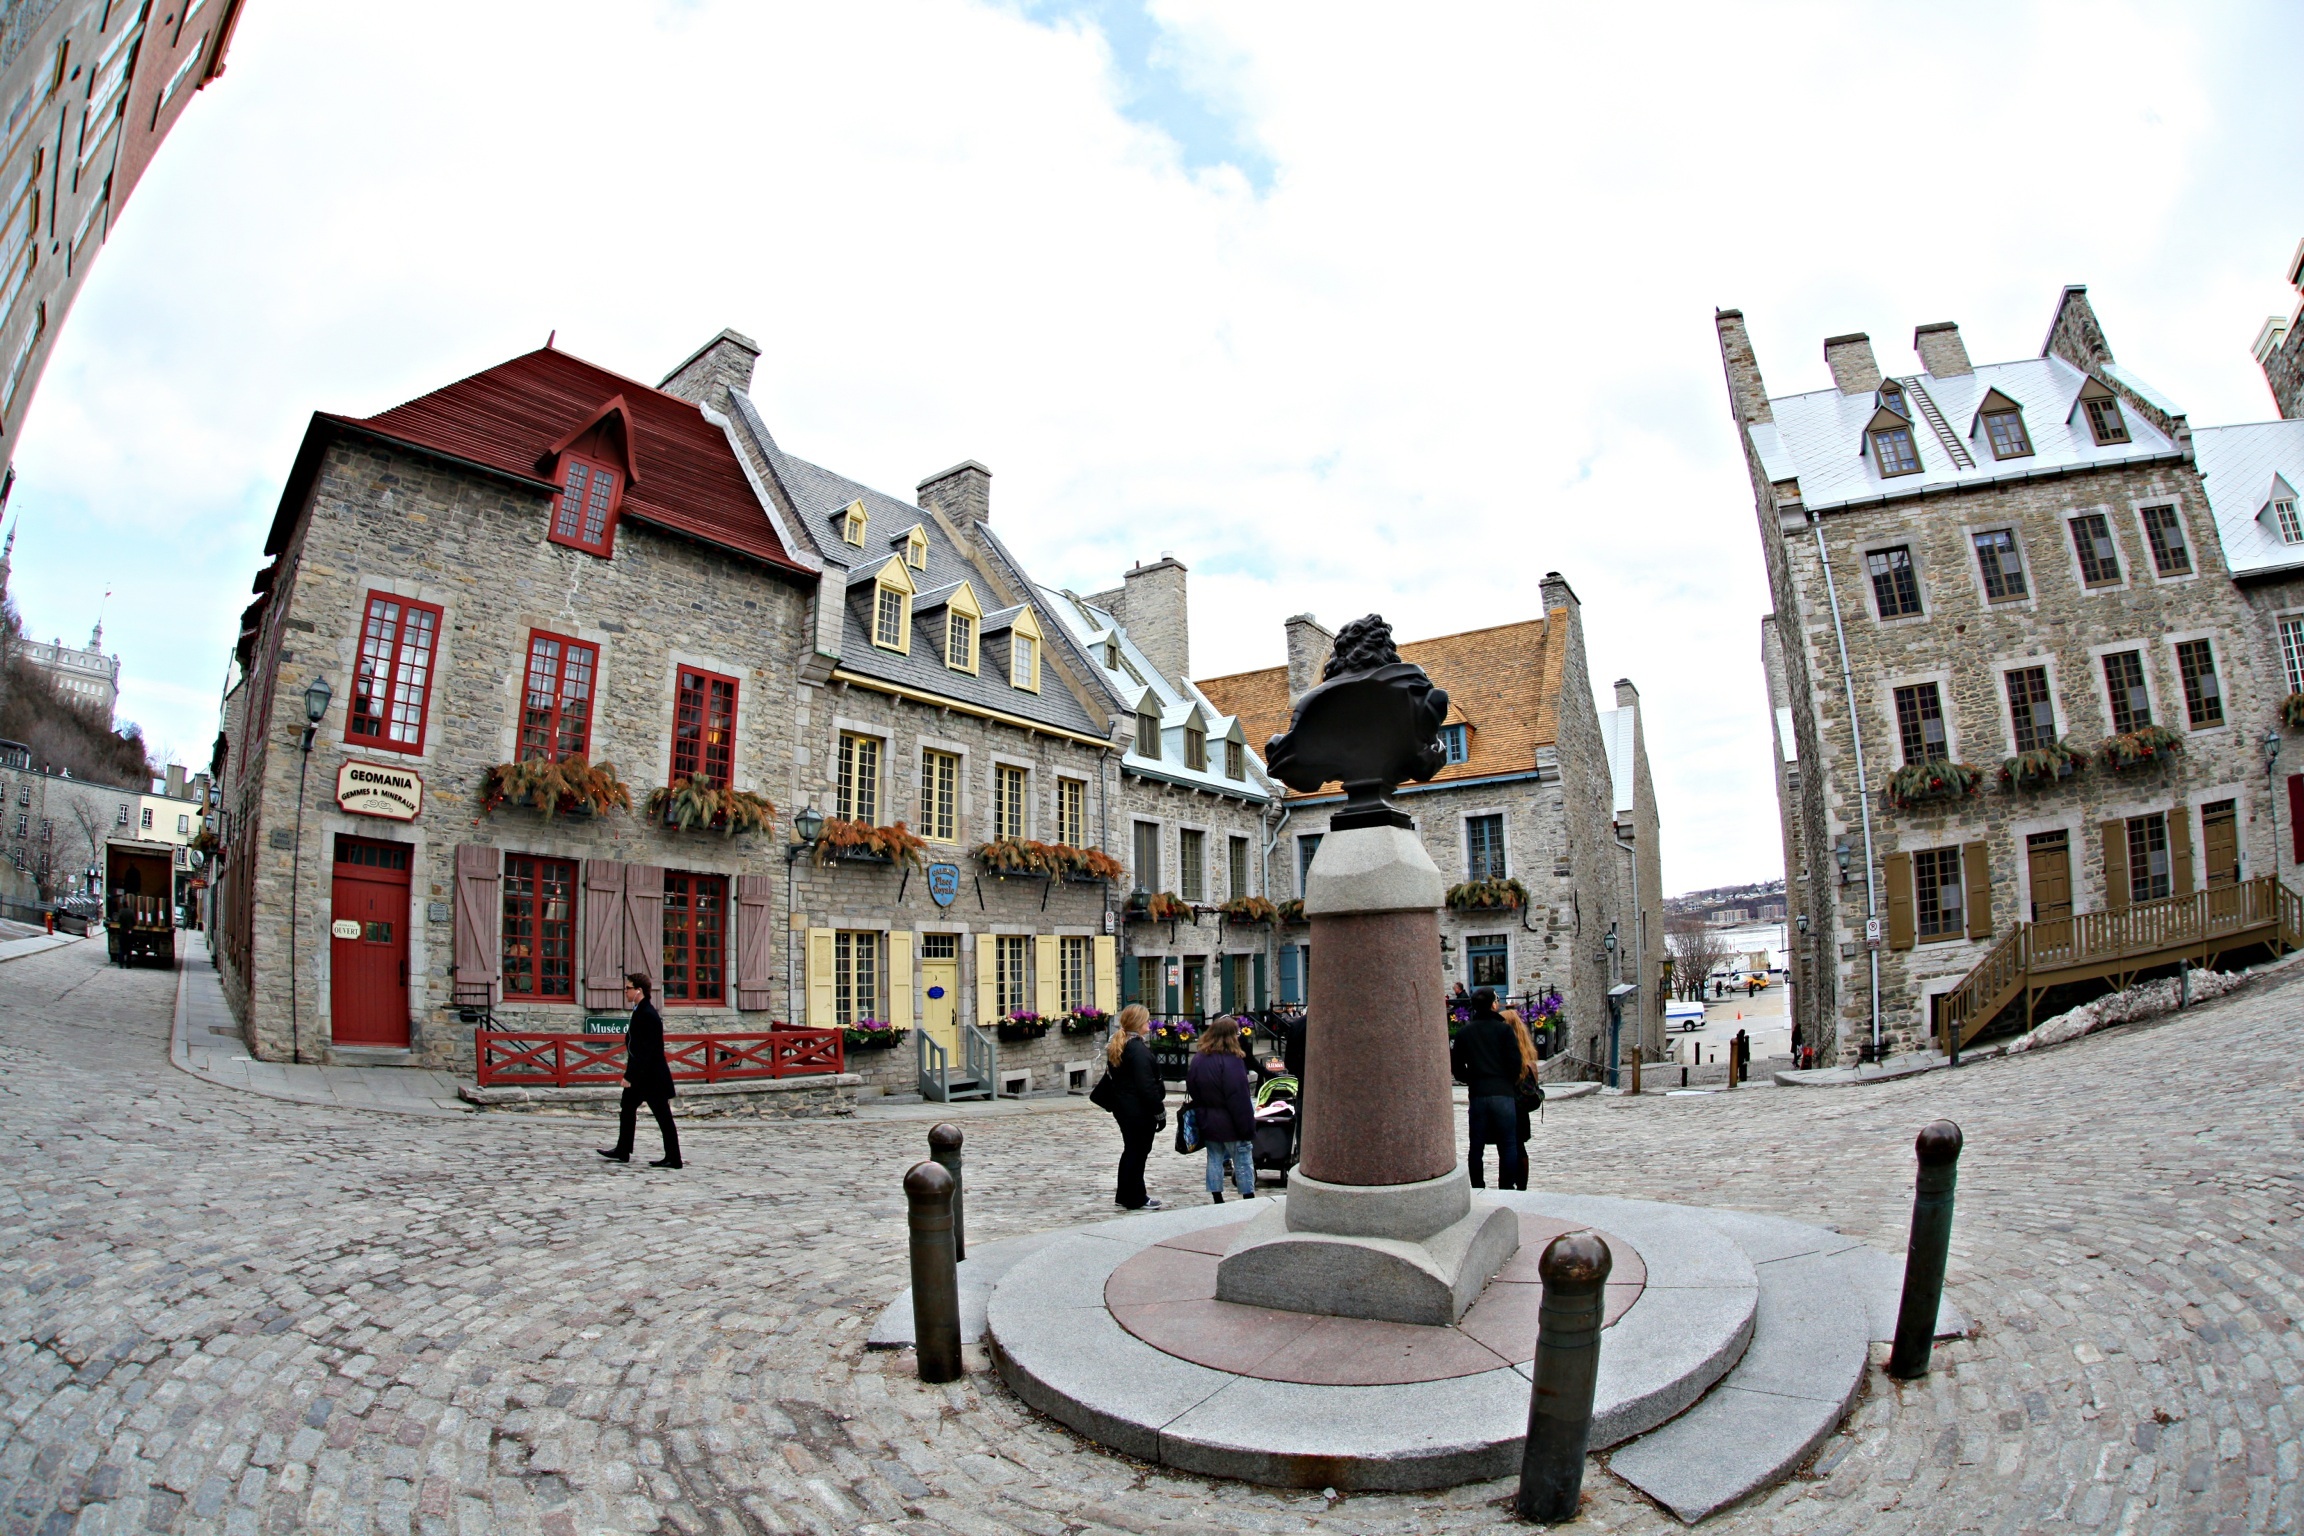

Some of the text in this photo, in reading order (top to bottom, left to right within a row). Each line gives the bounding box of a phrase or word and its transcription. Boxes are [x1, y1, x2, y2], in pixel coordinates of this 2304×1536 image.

[350, 769, 412, 789] GEOMANIA
[341, 788, 416, 812] GEMMES & MINERAUX
[935, 877, 953, 886] Place
[932, 885, 955, 896] Royale
[334, 926, 359, 936] OUVERT
[590, 1023, 629, 1034] Musée d
